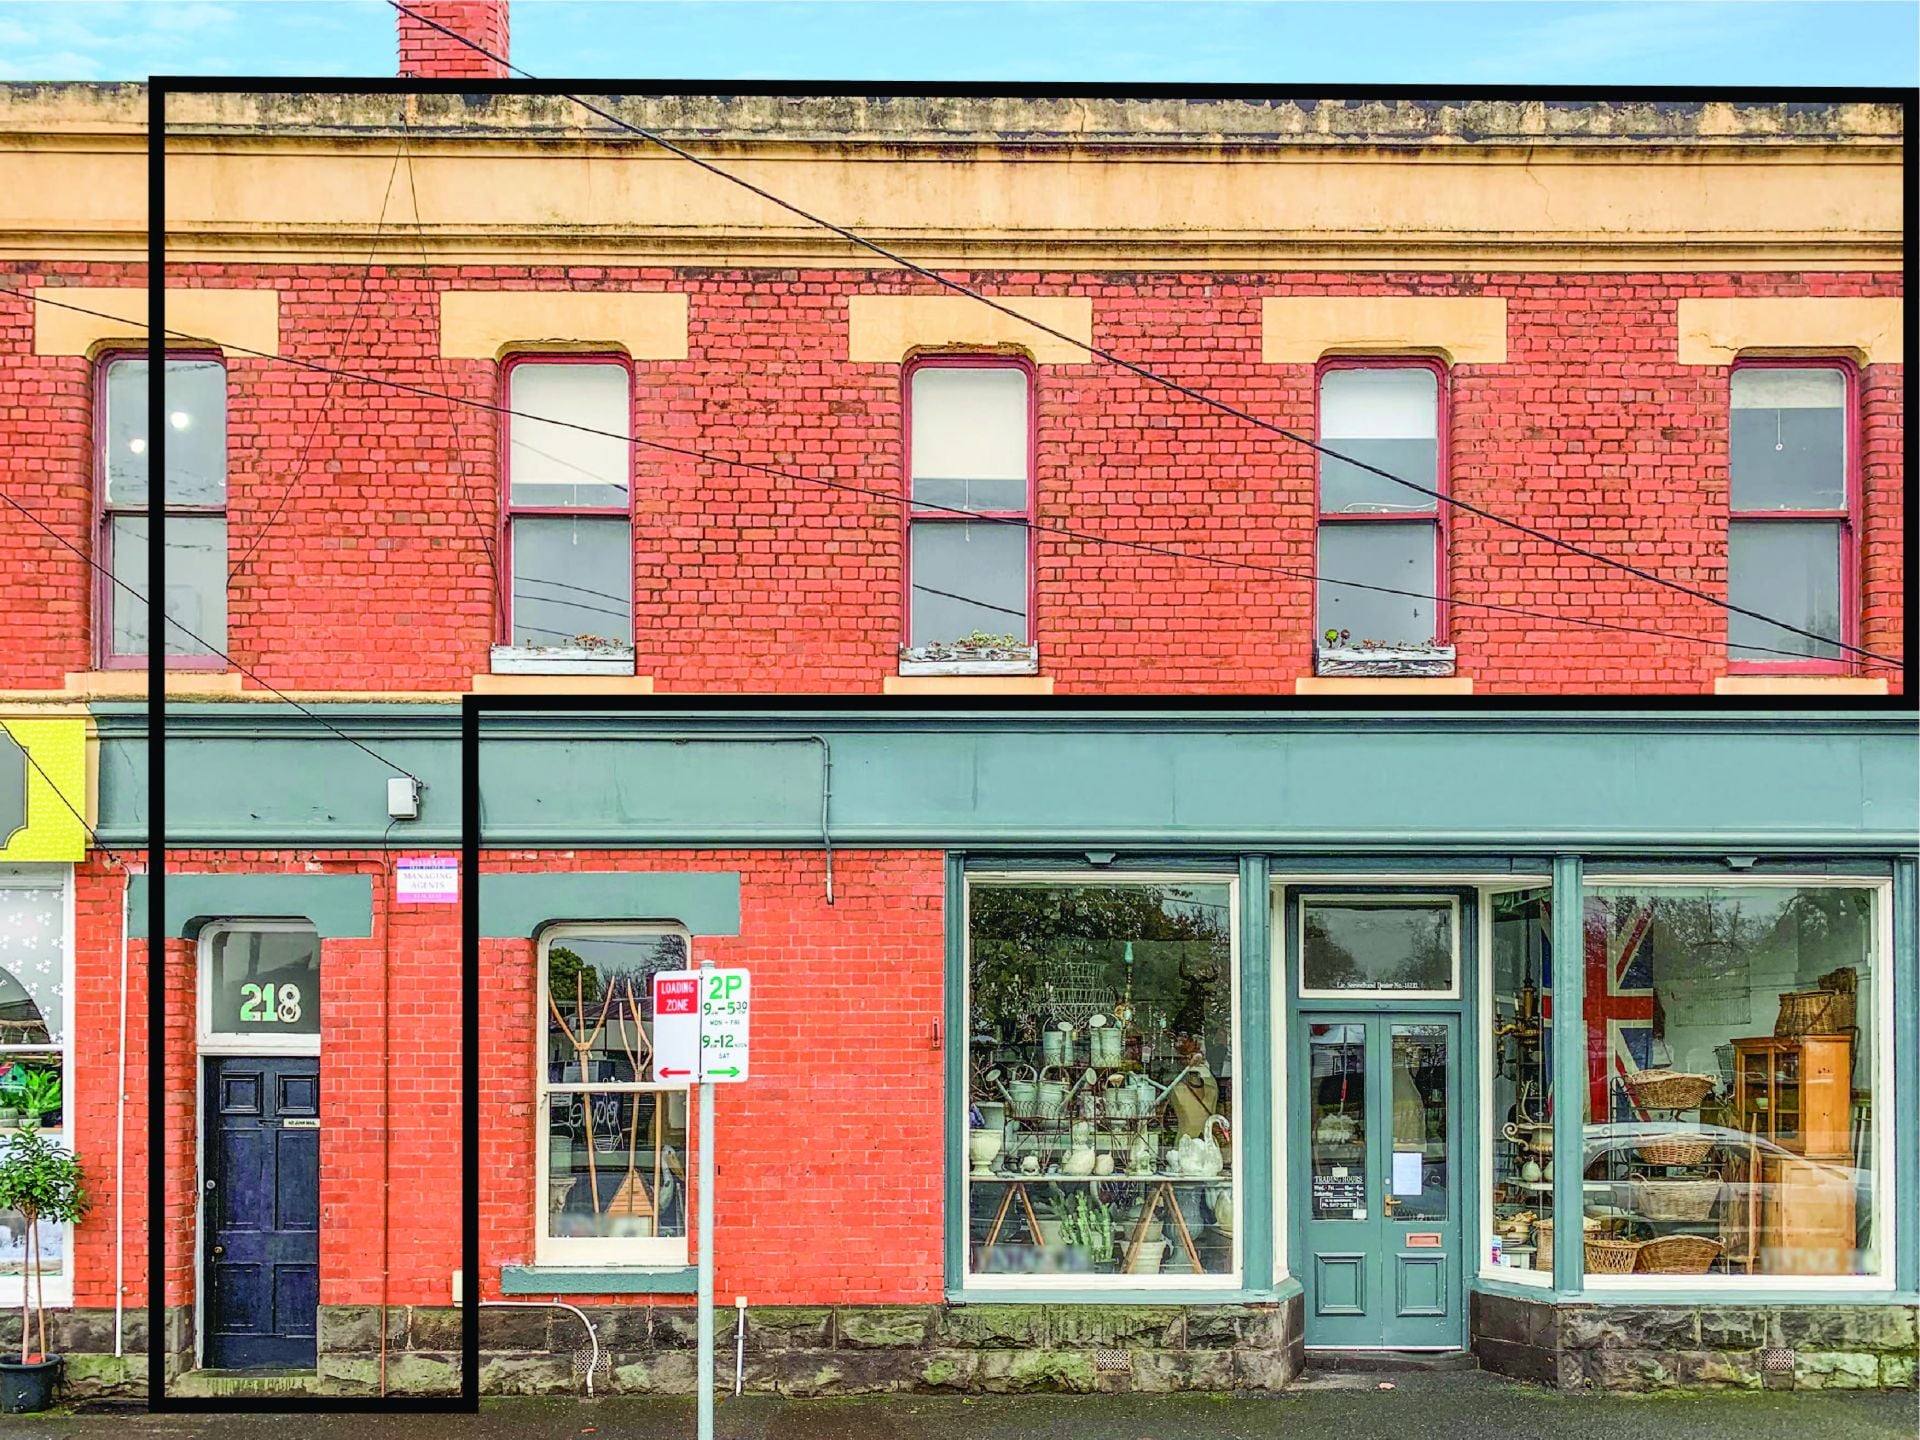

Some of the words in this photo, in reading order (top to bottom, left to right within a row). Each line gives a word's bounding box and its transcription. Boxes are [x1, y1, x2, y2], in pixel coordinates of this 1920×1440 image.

[661, 982, 694, 994] LOADING
[709, 976, 742, 999] 2P
[240, 983, 301, 1023] 218
[666, 999, 689, 1011] ZONE
